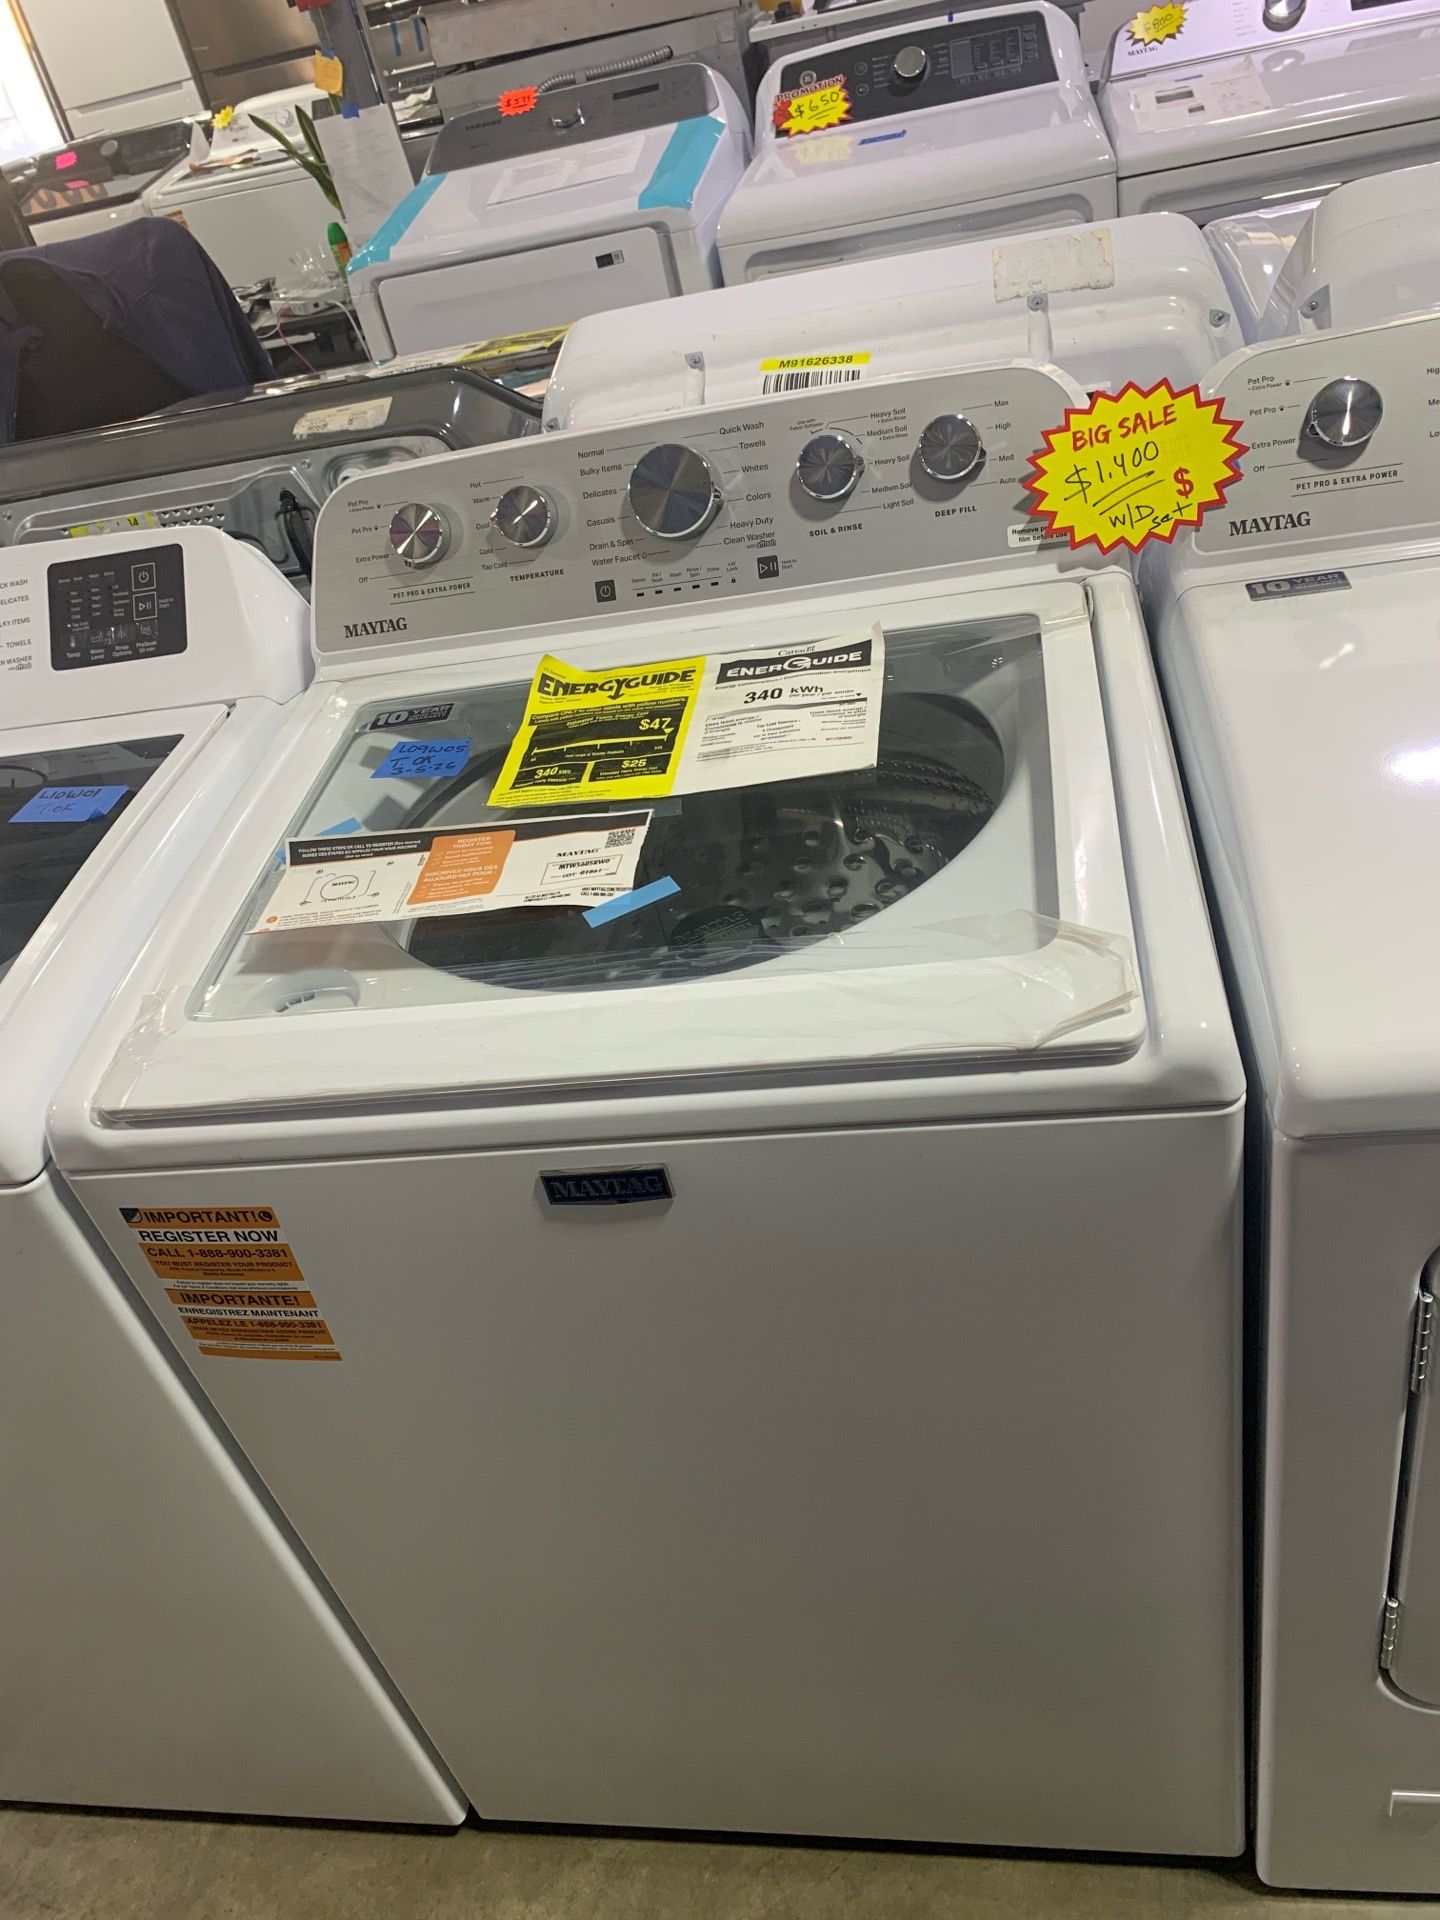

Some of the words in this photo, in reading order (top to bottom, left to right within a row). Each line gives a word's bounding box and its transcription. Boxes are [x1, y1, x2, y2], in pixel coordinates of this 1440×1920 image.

[777, 75, 844, 102] PROMOTION
[793, 92, 840, 119] $650
[779, 355, 853, 369] M91626338
[1426, 367, 1440, 375] Hig
[1248, 377, 1260, 385] Pet
[1262, 375, 1274, 384] Pro
[994, 400, 1010, 408] Max
[1250, 408, 1262, 416] Pet
[1264, 406, 1276, 415] Pro
[720, 425, 742, 436] Quick
[742, 421, 764, 431] Wash
[995, 422, 1012, 430] High
[1072, 424, 1113, 452] BIG
[1118, 404, 1177, 439] SALE
[740, 439, 766, 450] Towels
[1252, 441, 1272, 450] Extra
[1273, 437, 1296, 447] Power
[578, 448, 604, 459] Normal
[998, 454, 1014, 462] Med
[874, 458, 895, 466] Heavy
[896, 454, 910, 463] Soil
[580, 466, 600, 476] Bulky
[601, 463, 622, 473] Items
[742, 462, 768, 473] Whites
[1253, 464, 1266, 473] Off
[1000, 476, 1016, 485] Auto
[1174, 467, 1194, 499] $
[1296, 482, 1312, 490] PET
[1314, 479, 1330, 488] PRO
[1341, 475, 1368, 485] EXTRA
[1370, 470, 1398, 480] POWER
[582, 488, 617, 499] Delicates
[872, 486, 898, 494] Medium
[900, 482, 912, 490] Soil
[746, 491, 772, 502] Colors
[883, 502, 900, 510] Light
[902, 498, 914, 507] Soil
[935, 508, 956, 518] DEEP
[959, 505, 978, 514] FILL
[586, 516, 616, 527] Casuals
[730, 520, 754, 530] Heavy
[756, 517, 774, 526] Duty
[1229, 512, 1311, 536] MAYTAG
[810, 528, 828, 537] SOIL
[838, 523, 863, 533] RINSE
[1012, 527, 1039, 536] Remove
[724, 536, 746, 546] Clean
[746, 531, 776, 541] Washer
[1019, 534, 1032, 542] film
[1032, 532, 1054, 541] before
[590, 542, 610, 551] Drain
[616, 538, 634, 549] Spin
[356, 556, 370, 564] Extra
[372, 552, 390, 562] Power
[479, 548, 494, 556] Cold
[592, 556, 614, 567] Water
[614, 552, 640, 564] Faucet
[510, 569, 564, 582] TEMPERATURE
[10, 578, 28, 588] WASH
[428, 586, 448, 594] EXTRA
[450, 582, 471, 590] POWER
[1252, 580, 1291, 594] 10
[0, 594, 30, 606] ELICATES
[12, 616, 30, 626] ITEMS
[344, 617, 408, 638] MAYTAG
[6, 638, 32, 648] TOWELS
[6, 656, 32, 665] WASHER
[726, 651, 862, 678] ENERGUIDE
[738, 679, 778, 687] consumption
[784, 670, 832, 680] Consommation
[538, 670, 696, 700] ENERGYGUIDE
[744, 688, 783, 704] 340
[790, 686, 824, 694] kWh
[376, 711, 409, 726] 10
[639, 718, 672, 730] $47
[622, 759, 647, 768] $25
[534, 767, 559, 778] 340
[556, 848, 598, 858] MAYTAG
[551, 1176, 662, 1198] MAYTAG
[144, 1210, 258, 1224] IMPORTANT!
[138, 1230, 230, 1243] REGISTER
[234, 1230, 278, 1242] NOW
[147, 1248, 186, 1258] CALL
[188, 1248, 288, 1258] 1-888-900-3381
[180, 1292, 300, 1306] IMPORTANTE!
[178, 1307, 250, 1316] ENREGISTREZ
[250, 1308, 318, 1317] MAINTENANT
[187, 1318, 232, 1326] APPELEZ
[250, 1320, 322, 1328] 1-888-900-3381
